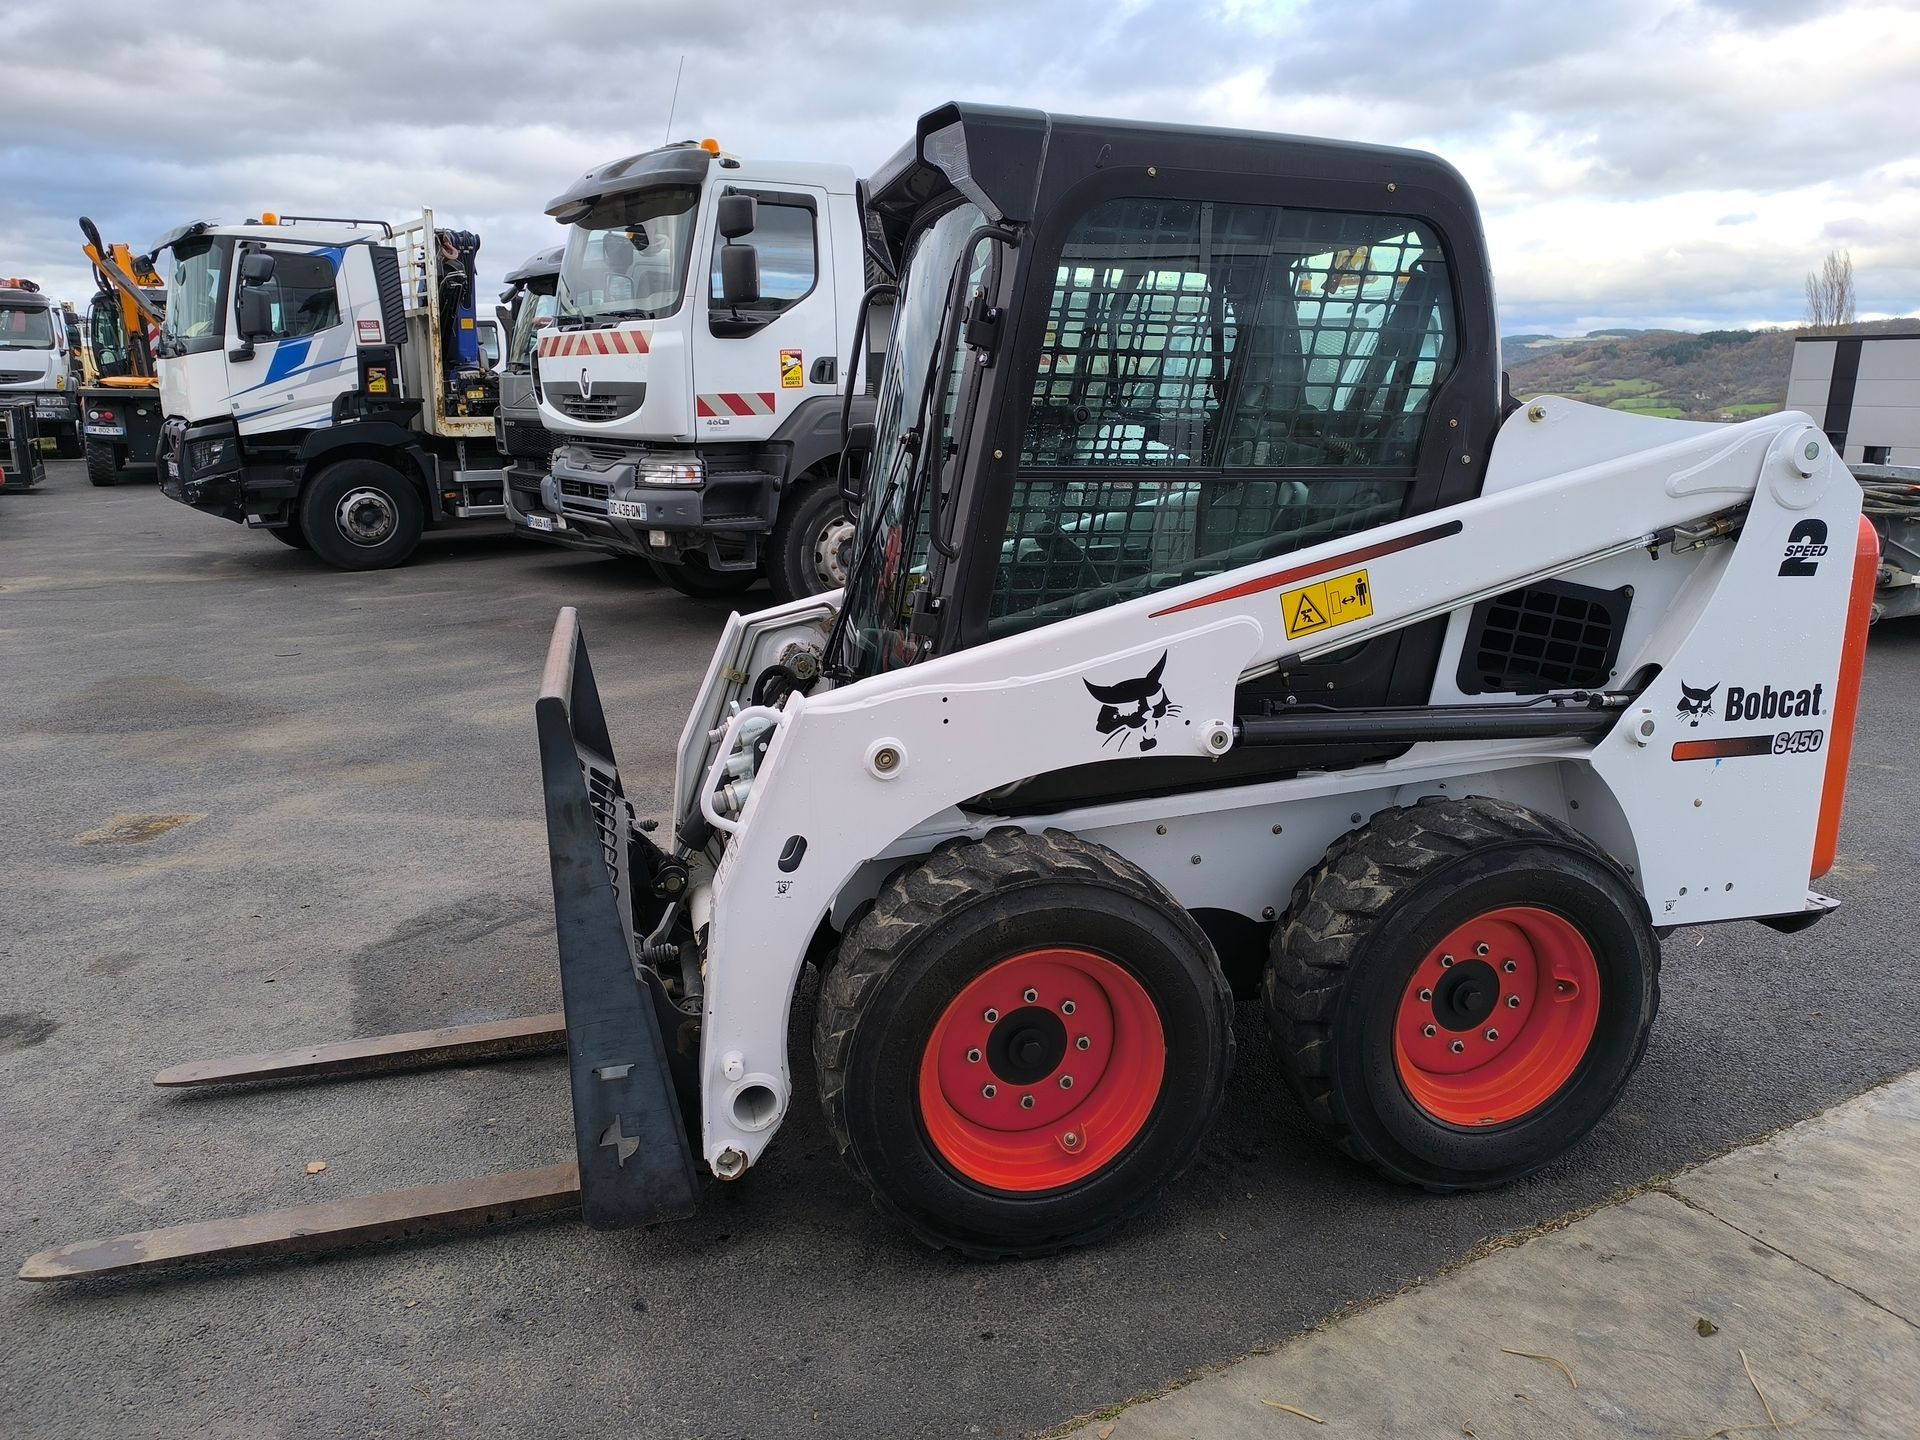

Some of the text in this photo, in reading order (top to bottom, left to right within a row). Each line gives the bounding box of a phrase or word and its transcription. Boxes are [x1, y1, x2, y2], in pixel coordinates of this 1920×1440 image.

[1778, 518, 1828, 577] 2
[1784, 544, 1829, 557] SPEED
[1724, 683, 1823, 722] Bobcat
[1774, 729, 1824, 755] S450
